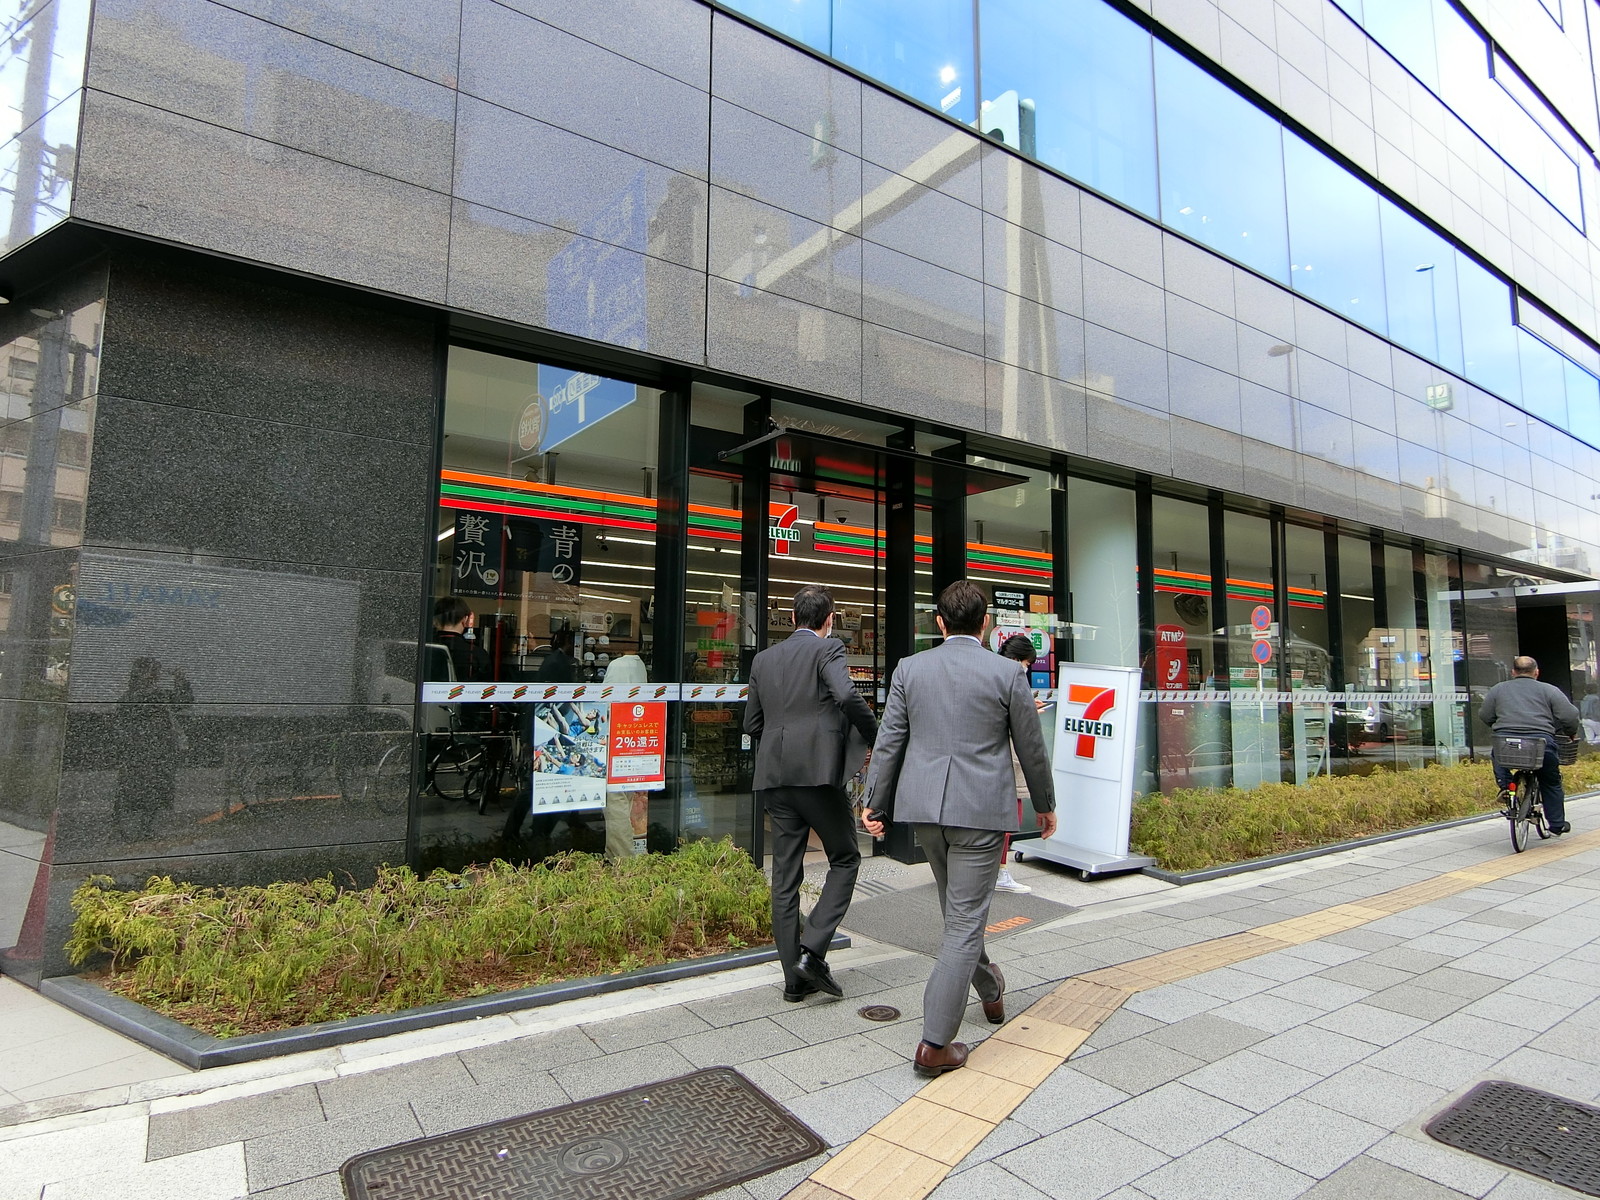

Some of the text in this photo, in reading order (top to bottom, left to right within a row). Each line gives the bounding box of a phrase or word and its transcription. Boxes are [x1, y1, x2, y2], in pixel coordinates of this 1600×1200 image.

[769, 527, 799, 540] LEVEn
[457, 514, 490, 580] 贅沢
[549, 525, 579, 583] 青の
[1030, 632, 1043, 650] 酒
[1160, 630, 1178, 642] ATM
[615, 736, 659, 748] 2%還元
